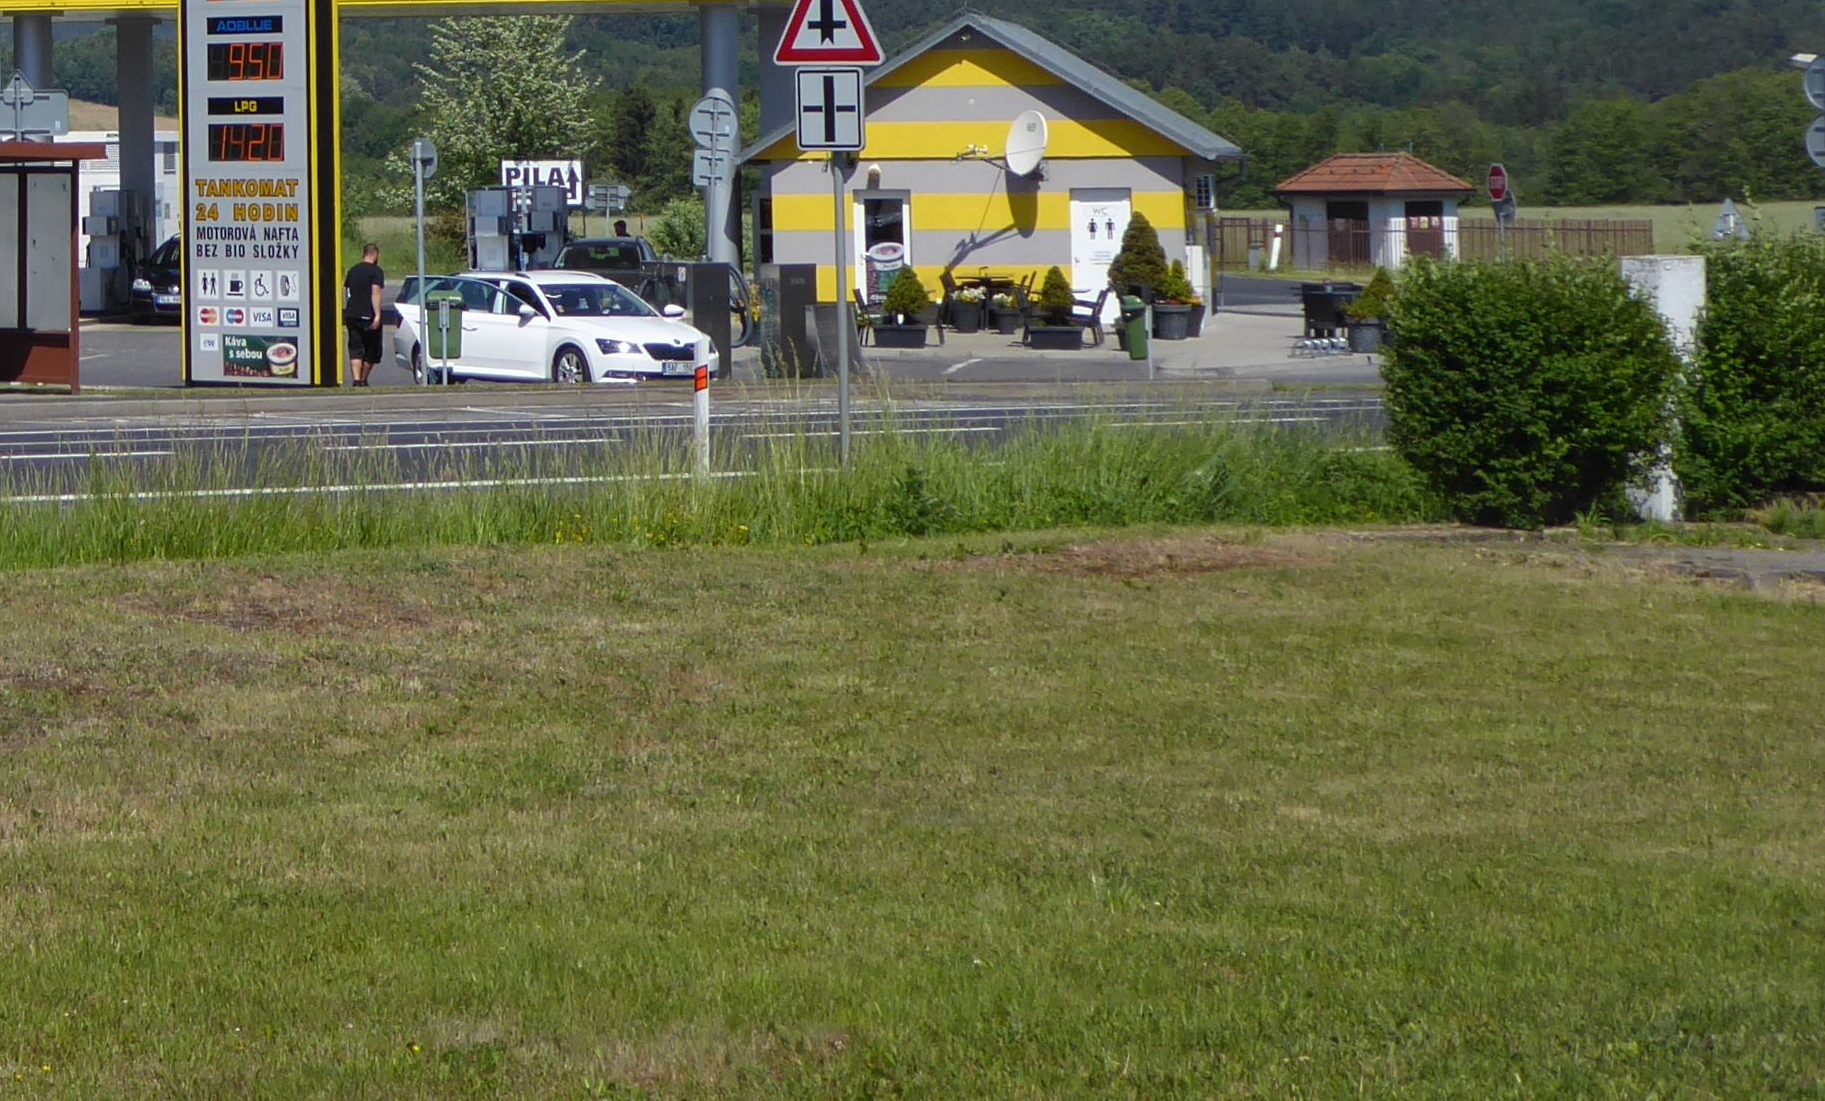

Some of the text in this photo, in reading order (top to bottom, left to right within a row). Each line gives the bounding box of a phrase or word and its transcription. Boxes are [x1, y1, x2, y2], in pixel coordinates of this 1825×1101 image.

[217, 20, 272, 32] ADBLUE
[234, 101, 257, 112] LPG
[506, 167, 566, 186] PILA
[195, 179, 299, 197] TANKOMAT
[195, 203, 299, 221] 24 HODIN
[1092, 206, 1108, 216] WC
[196, 225, 299, 241] MOTOROVÁ NAFTA
[196, 242, 299, 259] BEZ BIO SLOŽKY
[253, 312, 272, 322] VISA
[225, 336, 247, 347] Káva
[236, 348, 263, 359] sebou
